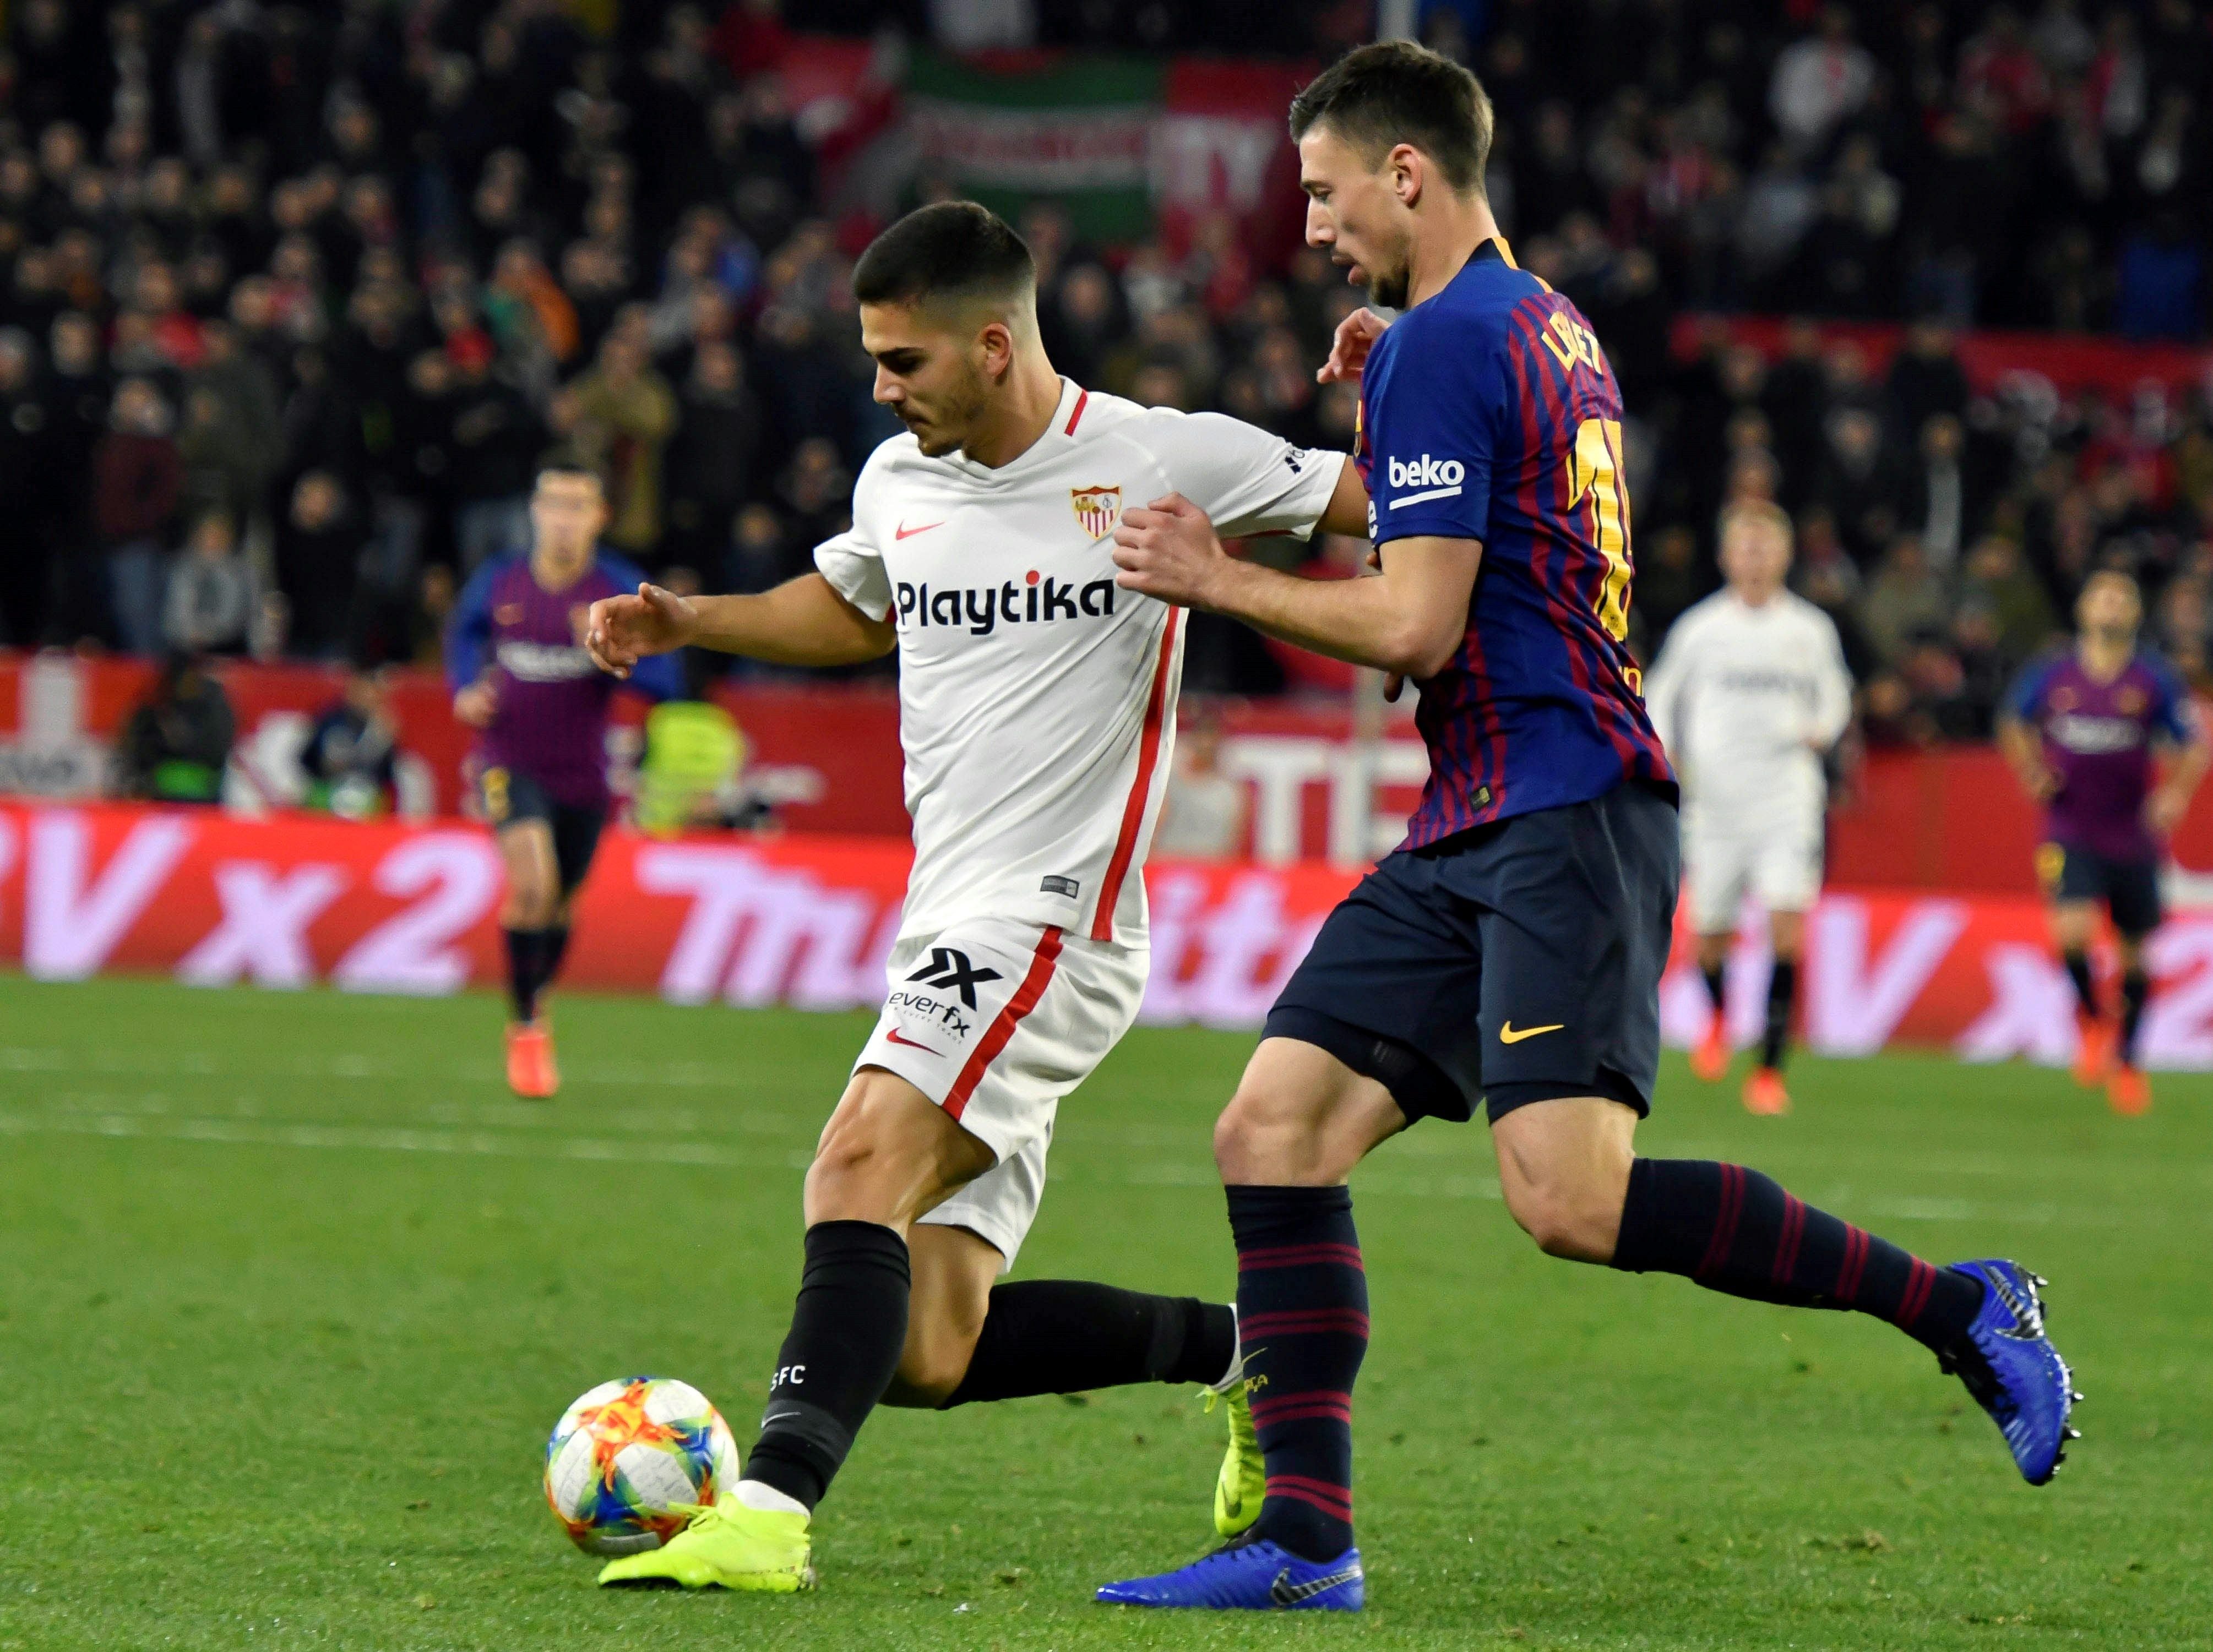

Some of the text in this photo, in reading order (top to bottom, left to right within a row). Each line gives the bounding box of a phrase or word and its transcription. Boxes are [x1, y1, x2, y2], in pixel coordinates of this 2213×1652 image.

[1389, 454, 1465, 488] beko
[898, 570, 1113, 635] Playtika
[889, 993, 971, 1038] everfx
